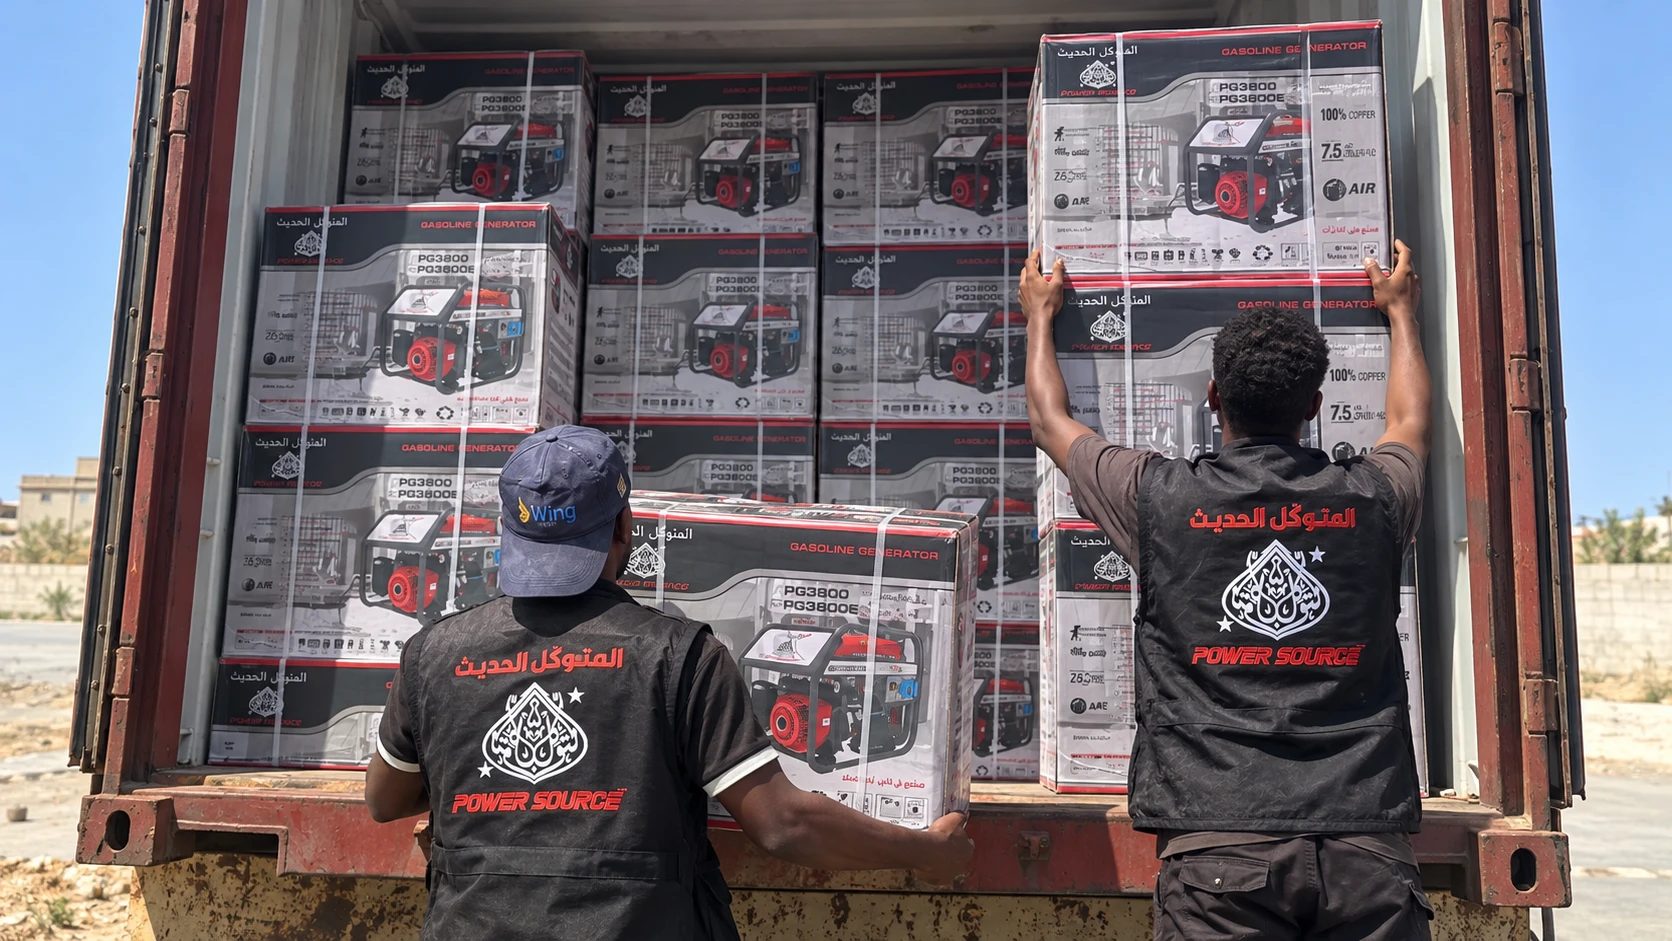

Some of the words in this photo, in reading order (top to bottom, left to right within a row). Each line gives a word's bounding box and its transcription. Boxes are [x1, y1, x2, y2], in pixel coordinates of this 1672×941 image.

[1057, 47, 1096, 58] الحديث
[1221, 46, 1282, 56] GASOLINE
[1286, 42, 1368, 54] GENERATOR
[1220, 82, 1276, 92] PG3800
[1220, 93, 1284, 103] PG3800E
[1320, 108, 1347, 121] 100%
[1321, 142, 1342, 159] 7.5
[1348, 182, 1376, 195] AIR
[276, 217, 310, 228] الحديث
[420, 221, 472, 229] GASOLINE
[418, 254, 469, 262] PG3800
[1330, 368, 1356, 382] 100%
[1330, 404, 1352, 421] 7.5
[255, 438, 288, 448] الحديث
[402, 444, 454, 452] GASOLINE
[400, 478, 452, 487] PG3800
[530, 504, 576, 523] Wing
[1190, 506, 1266, 533] الحديث
[1070, 535, 1110, 548] الحديث
[790, 542, 855, 554] GASOLINE
[858, 547, 939, 560] GENERATOR
[784, 586, 849, 599] PG3800
[784, 600, 859, 615] PG3800E
[1192, 646, 1273, 666] POWER
[1274, 646, 1362, 666] SOURCE
[455, 652, 529, 680] الحديث
[230, 672, 267, 683] الحديث
[452, 792, 530, 814] POWER
[530, 790, 626, 811] SOURCE
